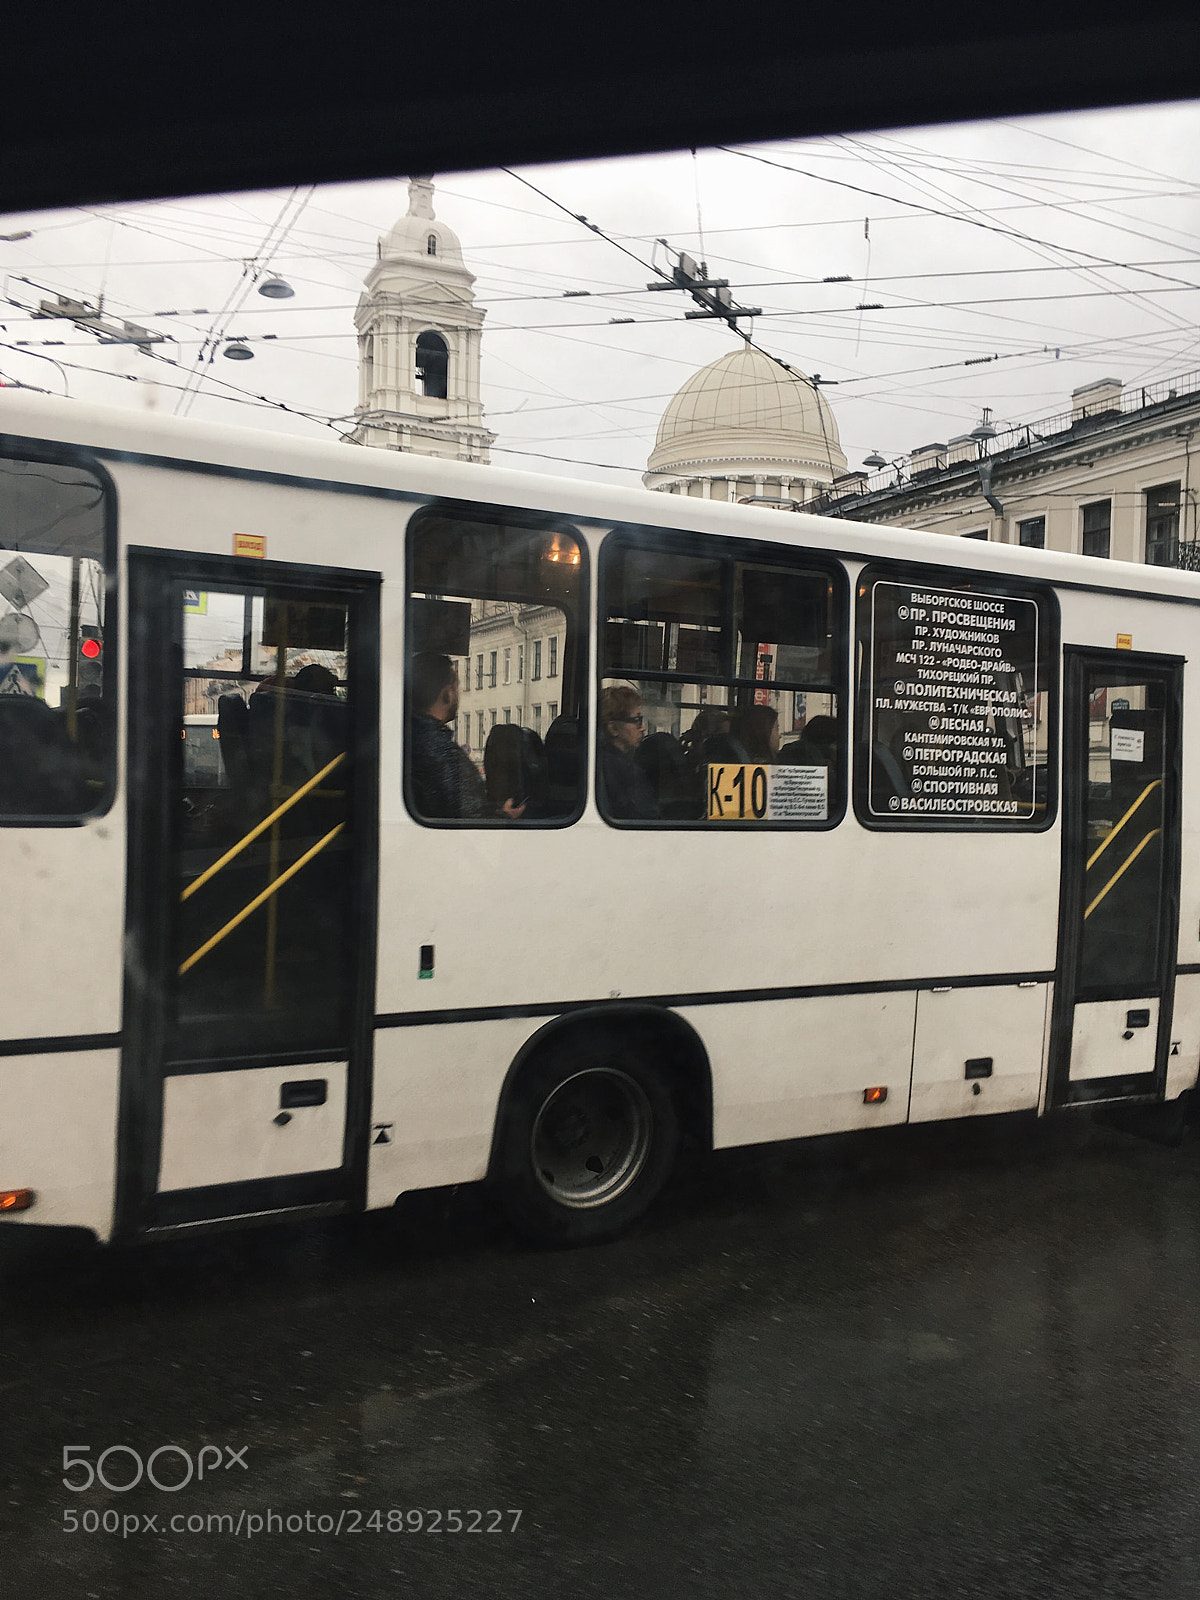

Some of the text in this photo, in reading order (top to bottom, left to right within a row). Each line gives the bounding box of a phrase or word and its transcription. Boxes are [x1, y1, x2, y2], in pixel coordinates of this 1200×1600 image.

[911, 593, 1005, 613] ВЫБОРГСКОЕ ШОССЕ
[910, 608, 929, 622] ПР.
[932, 610, 1016, 631] ПРОСВЕЩЕНИЯ
[915, 626, 1000, 644] ПР. ХУДОЖНИКОВ
[911, 640, 1002, 658] ПР. ЛУНАЧАРСКОГО
[896, 653, 917, 664] МСЧ
[919, 655, 935, 666] 122
[942, 657, 1016, 673] «РОДЕО-ДРАЙВ»
[917, 669, 996, 686] ТИХОРЕЦКИЙ ПР.
[906, 683, 1017, 703] ПОЛИТЕХНИЧЕСКАЯ
[875, 698, 892, 709] ПЛ.
[895, 700, 946, 713] МУЖЕСТВА
[953, 704, 968, 716] Т/К
[970, 705, 1032, 719] «ЕВРОПОЛИС»
[940, 718, 984, 732] ЛЕСНАЯ
[904, 732, 1006, 748] КАНТЕМИРОВСКАЯ УЛ.
[915, 748, 1007, 765] ПЕТРОГРАДСКАЯ
[913, 765, 998, 779] БОЛЬШОЙ ПР. П.С.
[710, 766, 767, 819] К-10
[923, 780, 998, 795] СПОРТИВНАЯ
[901, 797, 1018, 813] ВАСИЛЕОСТРОВСКАЯ
